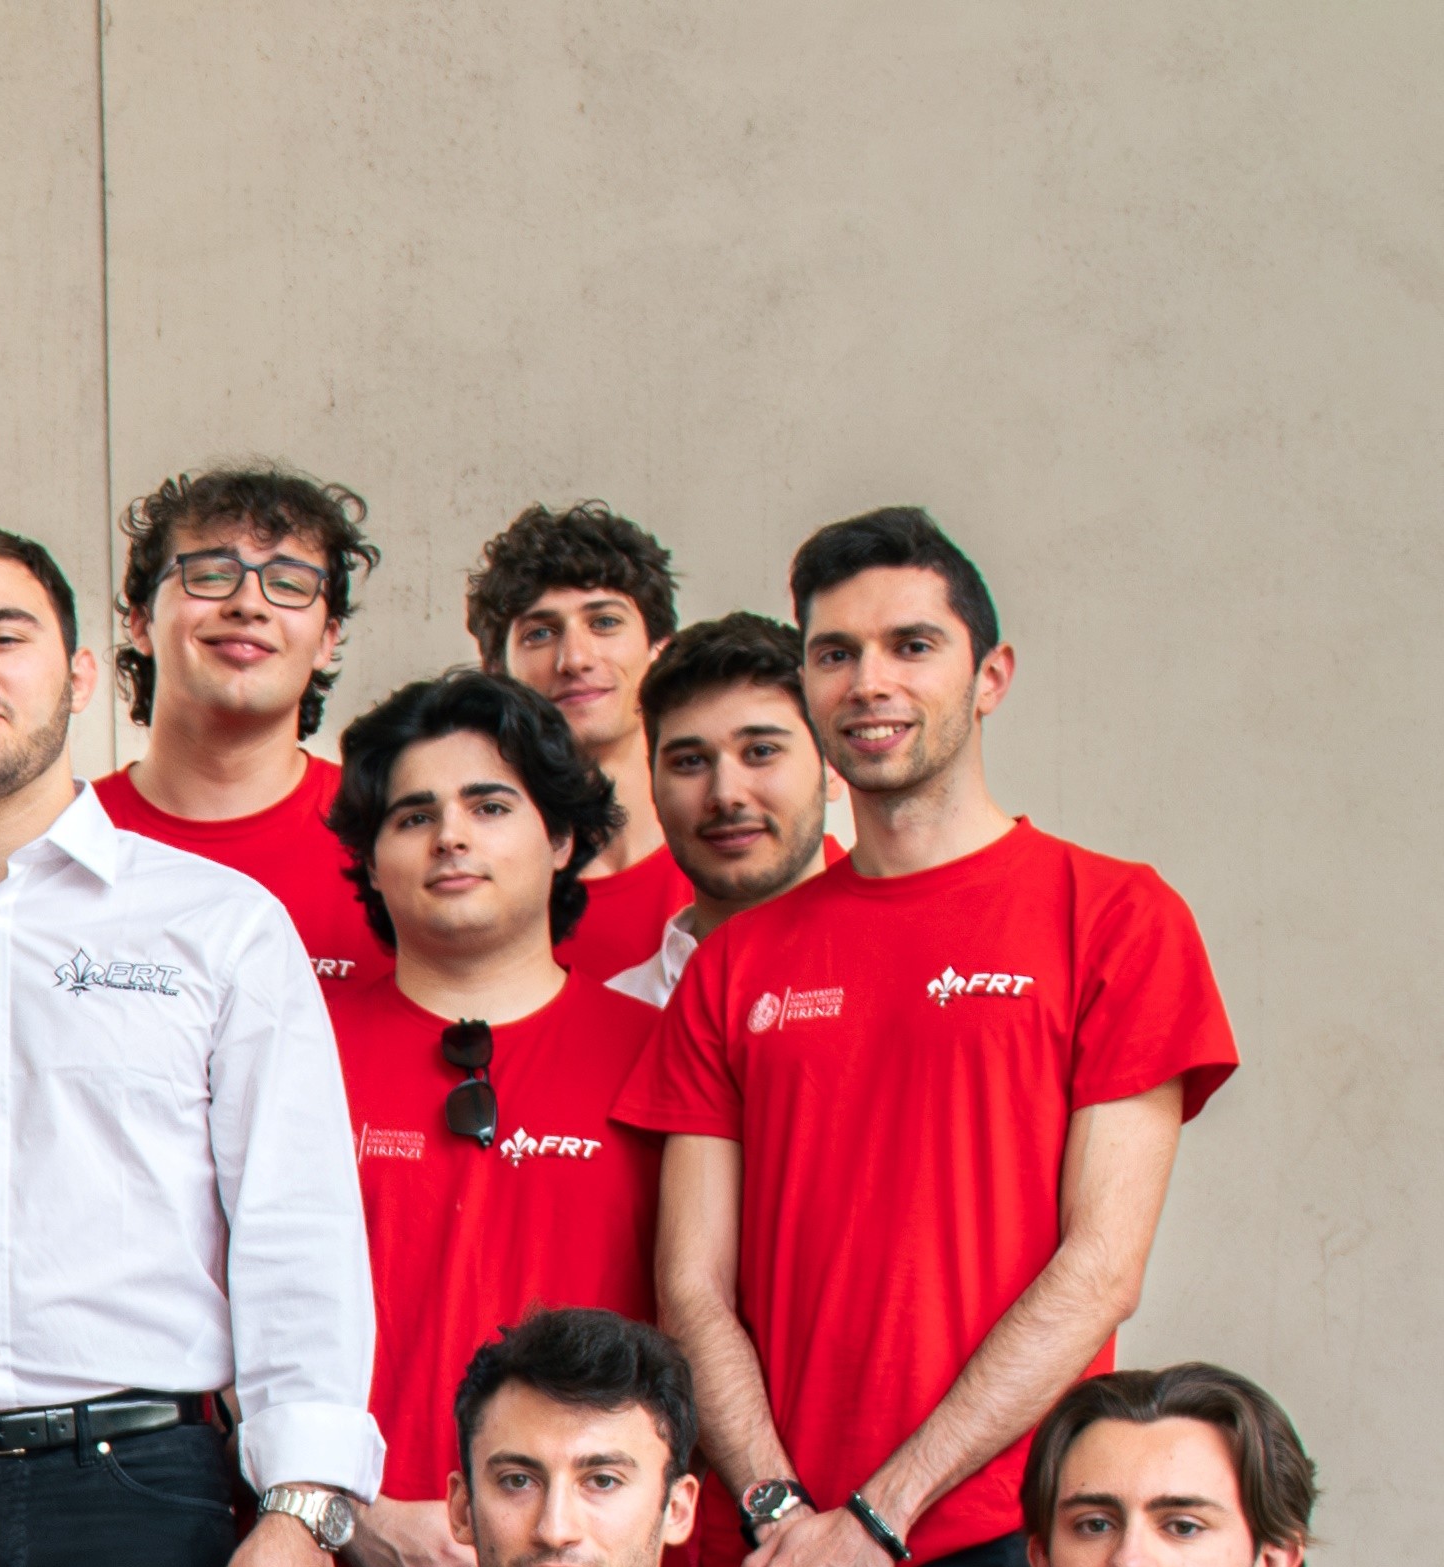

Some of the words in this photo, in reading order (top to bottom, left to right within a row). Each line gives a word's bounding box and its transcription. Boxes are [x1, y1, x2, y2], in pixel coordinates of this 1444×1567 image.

[106, 962, 182, 990] FRT
[310, 957, 356, 979] RT
[967, 973, 1034, 996] FRT
[787, 1005, 841, 1019] FIRENZE
[366, 1146, 424, 1159] FIRENZE
[539, 1135, 601, 1160] FRT
